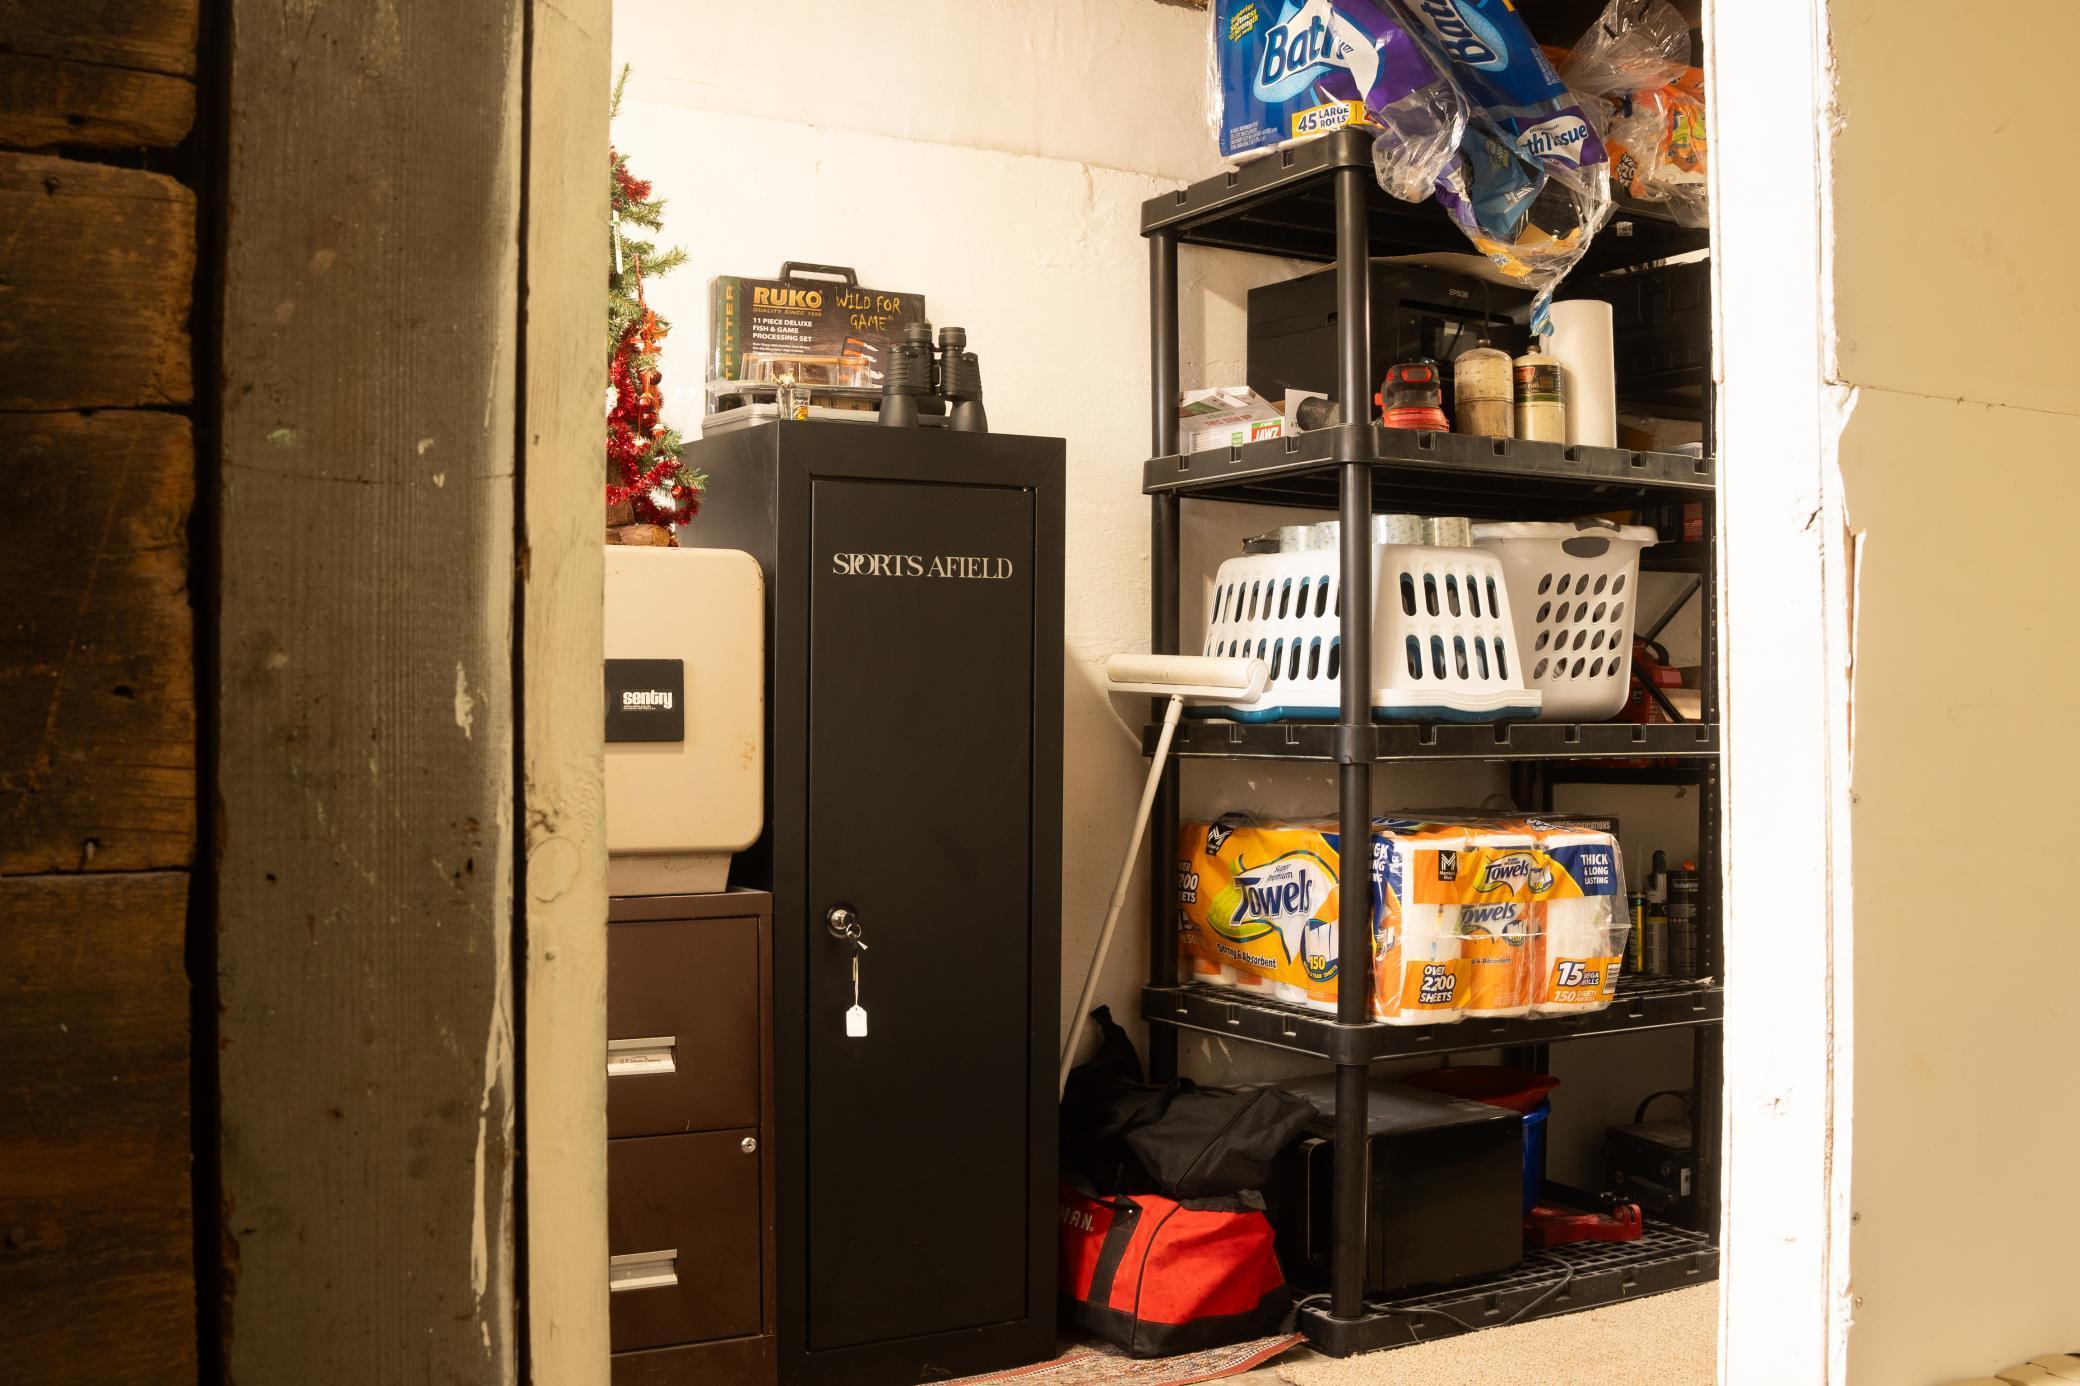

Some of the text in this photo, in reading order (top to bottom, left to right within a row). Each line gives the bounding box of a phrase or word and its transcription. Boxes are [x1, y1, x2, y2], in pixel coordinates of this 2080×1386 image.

[1297, 104, 1350, 133] 45 LARGE
[752, 287, 822, 308] RUKO
[834, 288, 902, 314] WILD FOR
[1448, 288, 1469, 298] EPSON
[776, 326, 799, 334] GAME
[784, 319, 813, 327] DELUXE
[849, 314, 887, 332] GAME
[752, 333, 798, 342] PROCESSING
[1252, 426, 1280, 442] JAWZ
[832, 552, 1014, 579] SPORTS AFIELD
[622, 689, 673, 710] sentry
[1580, 853, 1608, 866] THICK
[1484, 862, 1530, 885] Towels
[1588, 866, 1609, 876] LONG
[1584, 876, 1609, 885] LASTING
[1229, 868, 1313, 927] Towels
[1216, 943, 1238, 961] Strong
[1242, 951, 1278, 970] Absorbent
[1308, 954, 1327, 972] 150
[1557, 961, 1586, 987] 15
[1420, 975, 1456, 992] 2200
[1419, 992, 1453, 1004] SHEETS
